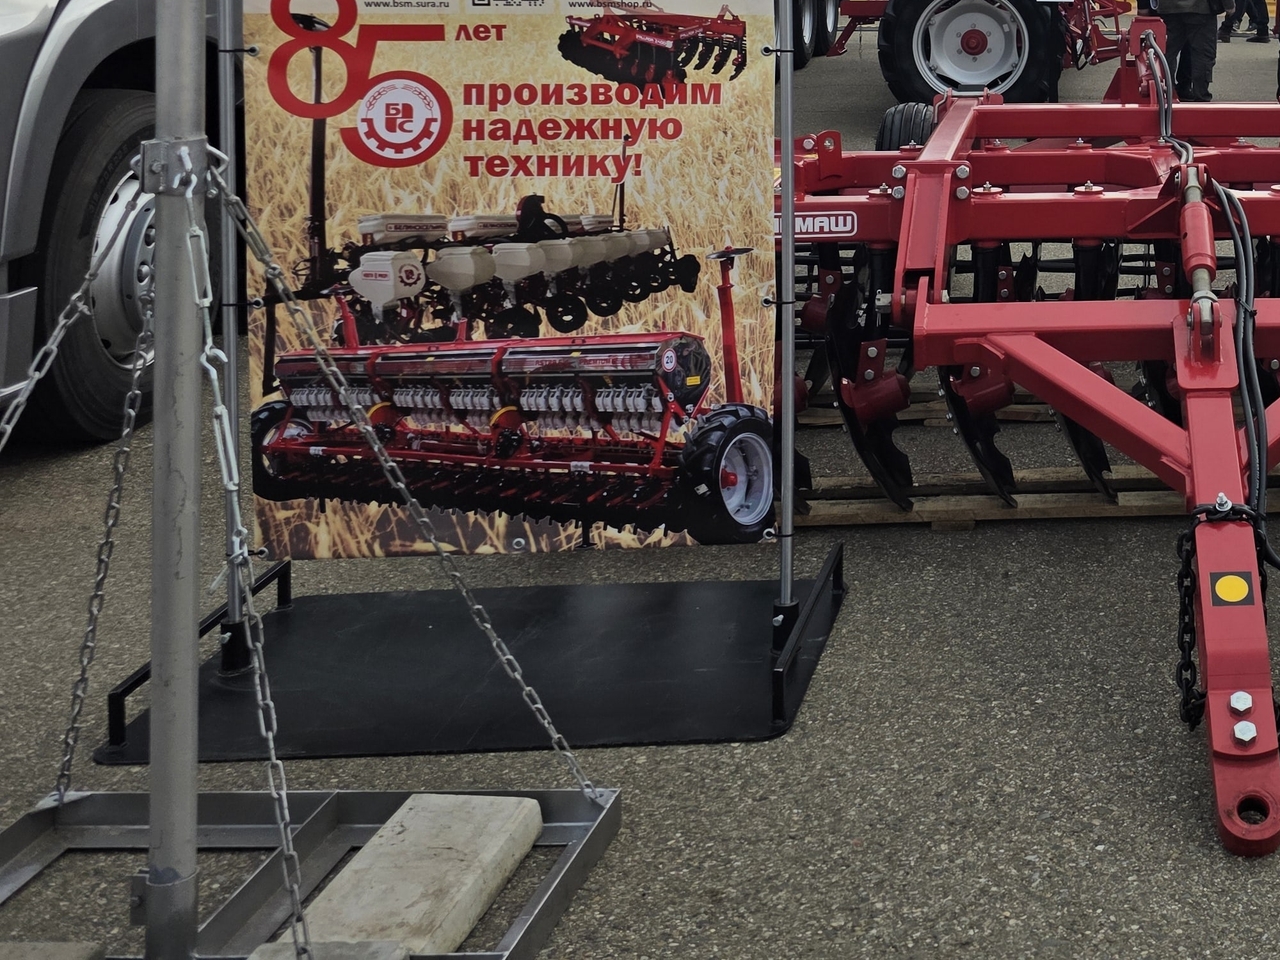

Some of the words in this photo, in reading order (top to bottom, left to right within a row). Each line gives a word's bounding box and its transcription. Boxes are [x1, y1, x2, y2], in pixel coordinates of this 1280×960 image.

[364, 0, 450, 8] www.bsm.sura.ru
[568, 0, 652, 9] www.bsmshop.ru
[454, 24, 506, 41] лет
[463, 83, 722, 112] производим
[463, 117, 683, 147] надежную
[463, 153, 643, 182] технику!
[665, 355, 674, 364] 20
